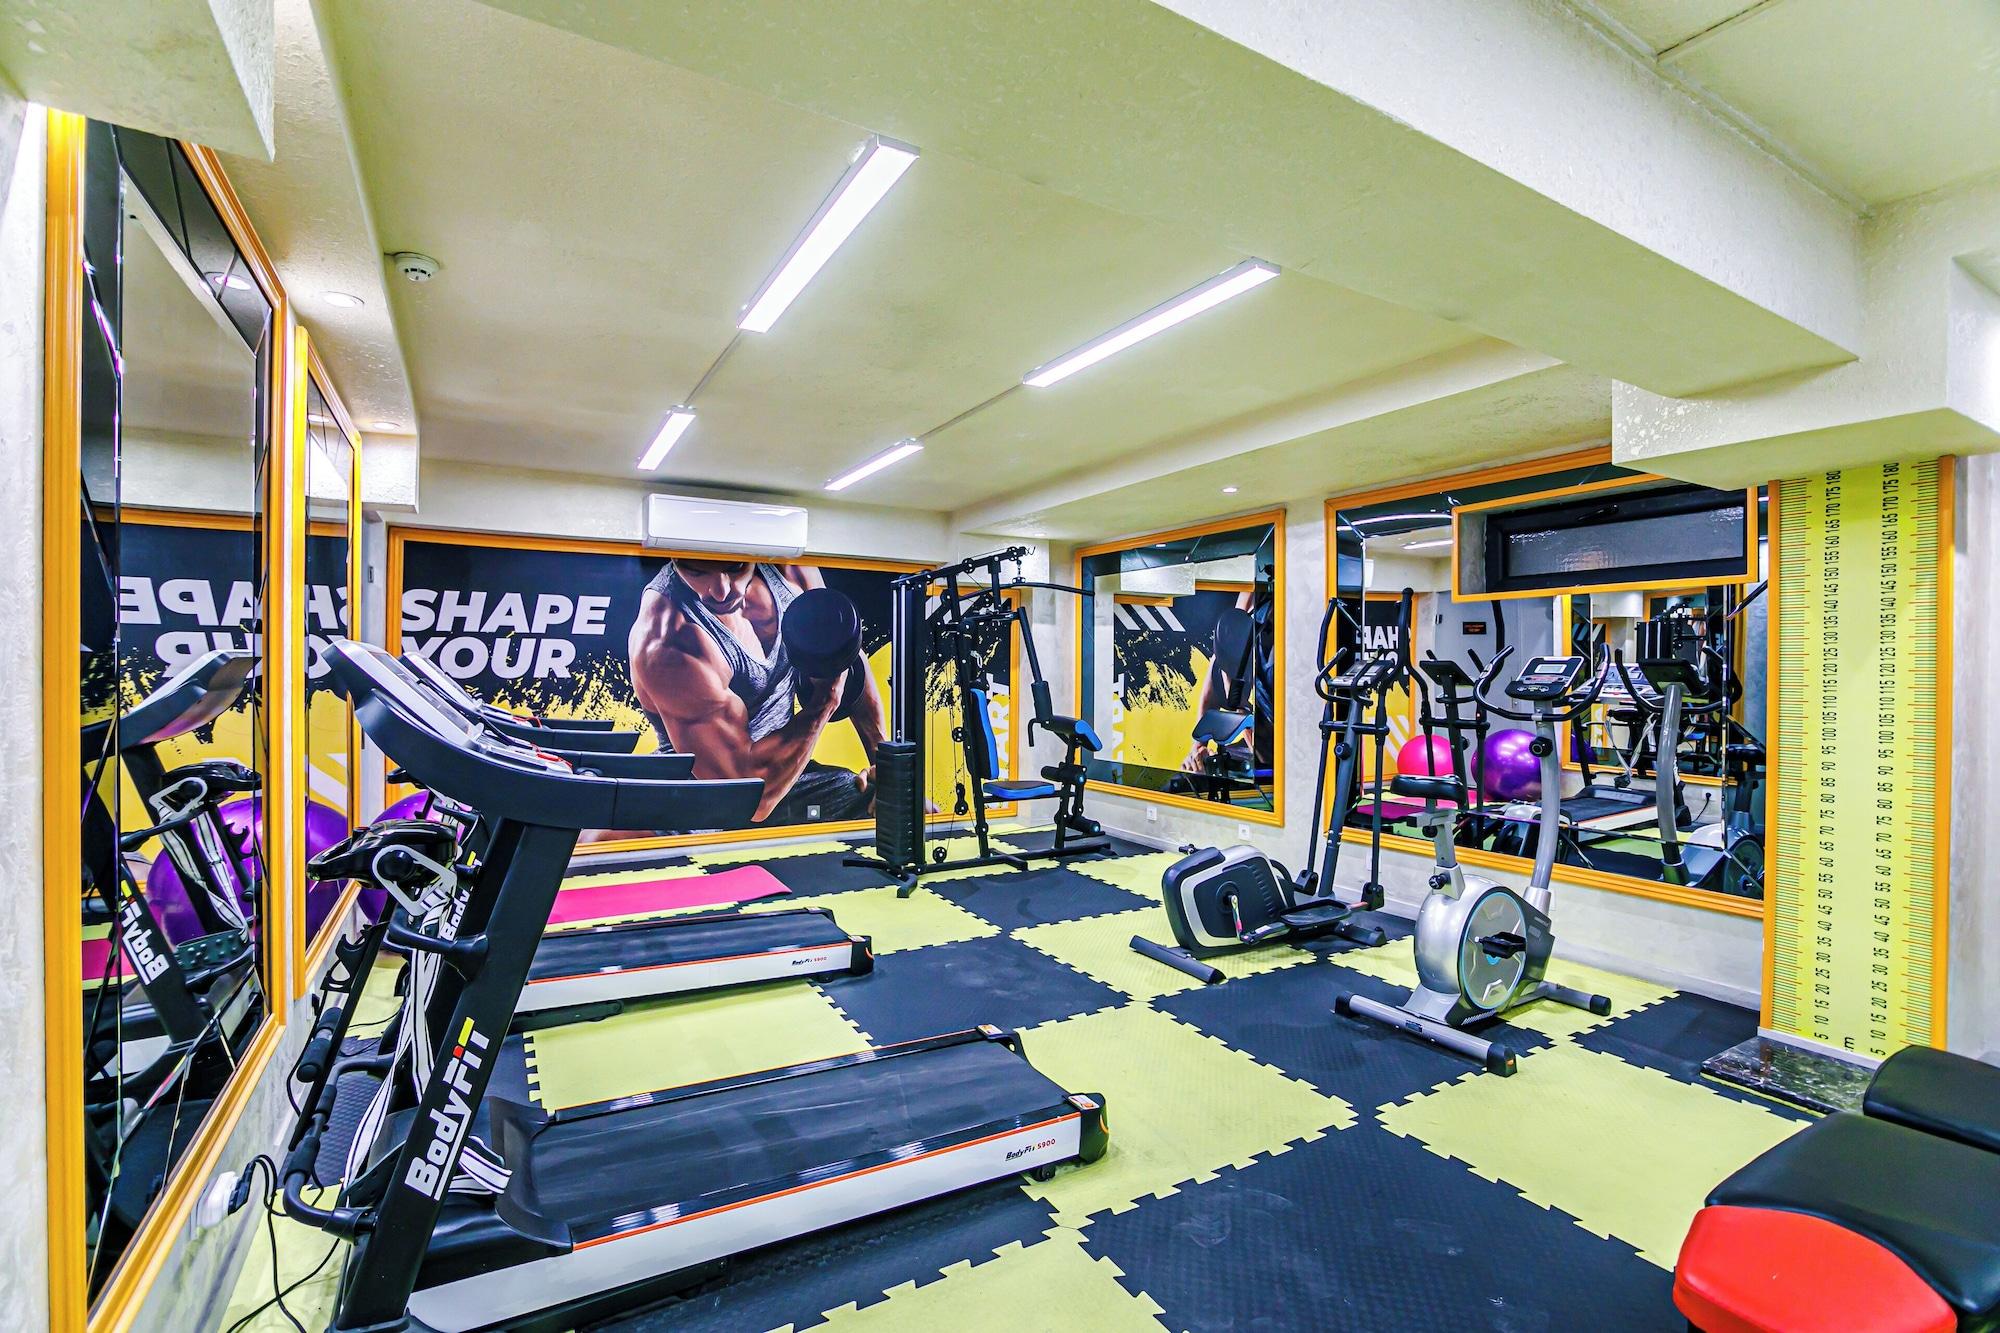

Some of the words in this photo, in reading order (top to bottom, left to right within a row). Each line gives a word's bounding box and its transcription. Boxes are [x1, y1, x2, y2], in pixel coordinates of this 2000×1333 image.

[1883, 462, 1899, 478] 180
[1826, 469, 1841, 486] 180
[1883, 478, 1899, 495] 175
[1826, 486, 1840, 502] 175
[1826, 502, 1840, 518] 170
[1882, 495, 1898, 512] 170
[1825, 518, 1840, 534] 165
[1882, 512, 1898, 529] 165
[1825, 535, 1839, 550] 160
[1882, 530, 1897, 546] 160
[1825, 550, 1839, 565] 155
[1881, 545, 1897, 561] 155
[1824, 567, 1839, 582] 150
[1881, 563, 1896, 578] 150
[1824, 583, 1838, 598] 145
[1881, 579, 1896, 595] 145
[1824, 599, 1838, 614] 140
[1880, 596, 1896, 612] 140
[401, 588, 611, 635] SHAPE
[1824, 615, 1838, 630] 135
[1880, 613, 1896, 628] 135
[1824, 631, 1838, 646] 130
[1880, 630, 1896, 645] 130
[402, 636, 577, 680] YOUR
[1823, 647, 1838, 662] 125
[1880, 646, 1895, 662] 125
[1823, 662, 1837, 677] 120
[1880, 663, 1895, 678] 120
[1823, 679, 1837, 694] 115
[1880, 679, 1895, 695] 115
[1823, 695, 1837, 709] 110
[1879, 696, 1895, 711] 110
[1822, 711, 1837, 725] 105
[1879, 713, 1894, 728] 105
[1822, 727, 1836, 742] 100
[1878, 730, 1894, 745] 100
[1822, 744, 1836, 755] 95
[1878, 748, 1894, 759] 95
[1821, 761, 1836, 771] 90
[1878, 765, 1893, 776] 90
[1821, 776, 1835, 788] 85
[1877, 781, 1893, 793] 85
[1820, 793, 1835, 804] 80
[1877, 798, 1892, 810] 80
[1820, 808, 1834, 820] 75
[1876, 815, 1892, 826] 75
[1820, 825, 1834, 836] 70
[1876, 832, 1892, 843] 70
[1820, 840, 1834, 852] 65
[1876, 848, 1891, 860] 65
[1819, 856, 1833, 868] 60
[1819, 872, 1833, 884] 55
[1875, 865, 1891, 877] 60
[1818, 888, 1832, 900] 50
[1875, 881, 1891, 893] 55
[1818, 904, 1832, 916] 45
[1874, 897, 1890, 910] 50
[1818, 920, 1832, 932] 40
[1874, 914, 1890, 927] 45
[1817, 935, 1831, 948] 35
[1874, 931, 1889, 943] 40
[1816, 951, 1830, 964] 30
[1873, 946, 1889, 959] 35
[1815, 967, 1830, 980] 25
[1872, 963, 1888, 976] 30
[1815, 983, 1829, 996] 20
[1872, 980, 1887, 993] 25
[1815, 998, 1829, 1010] 15
[1871, 996, 1887, 1010] 20
[1814, 1014, 1829, 1026] 10
[1871, 1012, 1886, 1025] 15
[1814, 1031, 1828, 1040] 5
[1870, 1029, 1886, 1041] 10
[1844, 1036, 1856, 1052] m
[1870, 1047, 1886, 1056] 5
